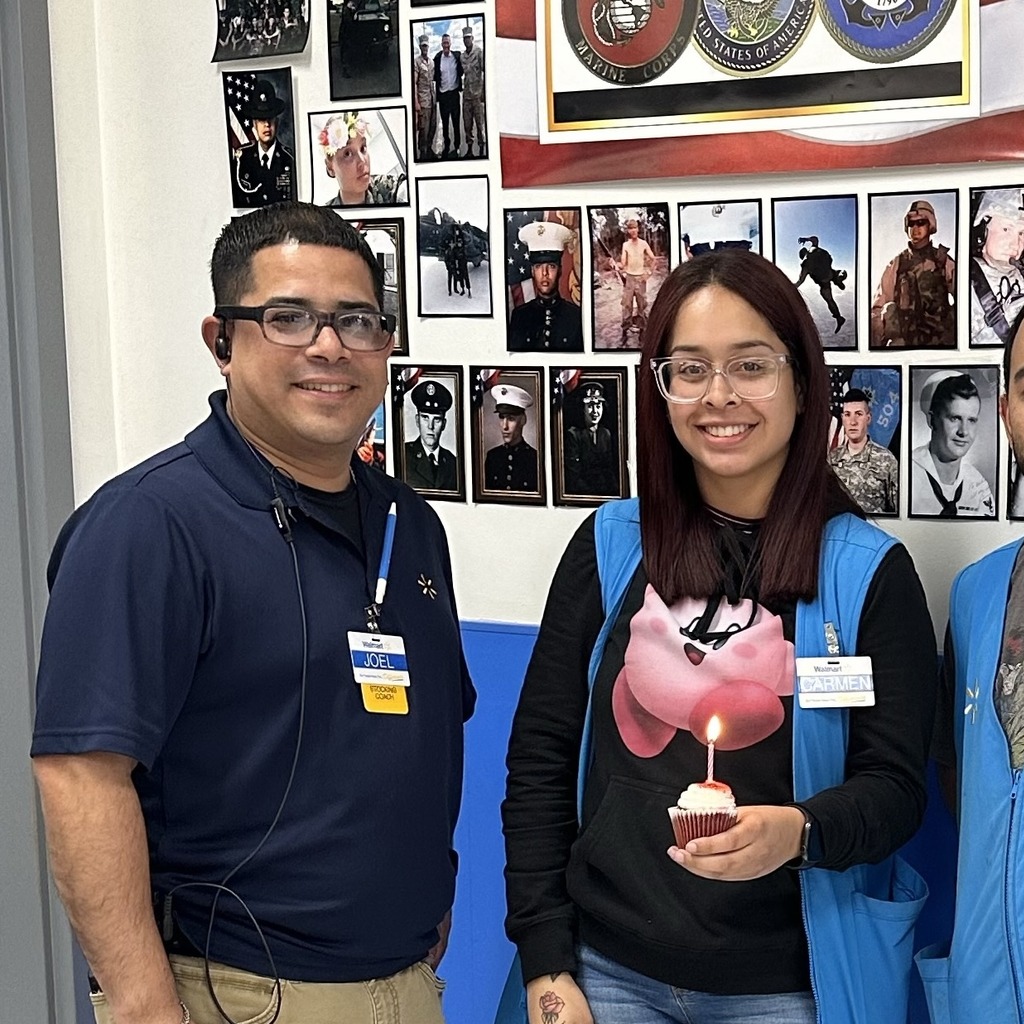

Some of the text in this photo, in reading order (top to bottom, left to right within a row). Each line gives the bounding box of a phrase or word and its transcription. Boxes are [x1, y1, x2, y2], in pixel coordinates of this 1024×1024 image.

[575, 35, 685, 82] MARINE CORPS
[712, 38, 752, 60] STATES
[755, 44, 770, 58] OF
[364, 653, 395, 669] JOEL
[801, 675, 872, 692] CARMEN
